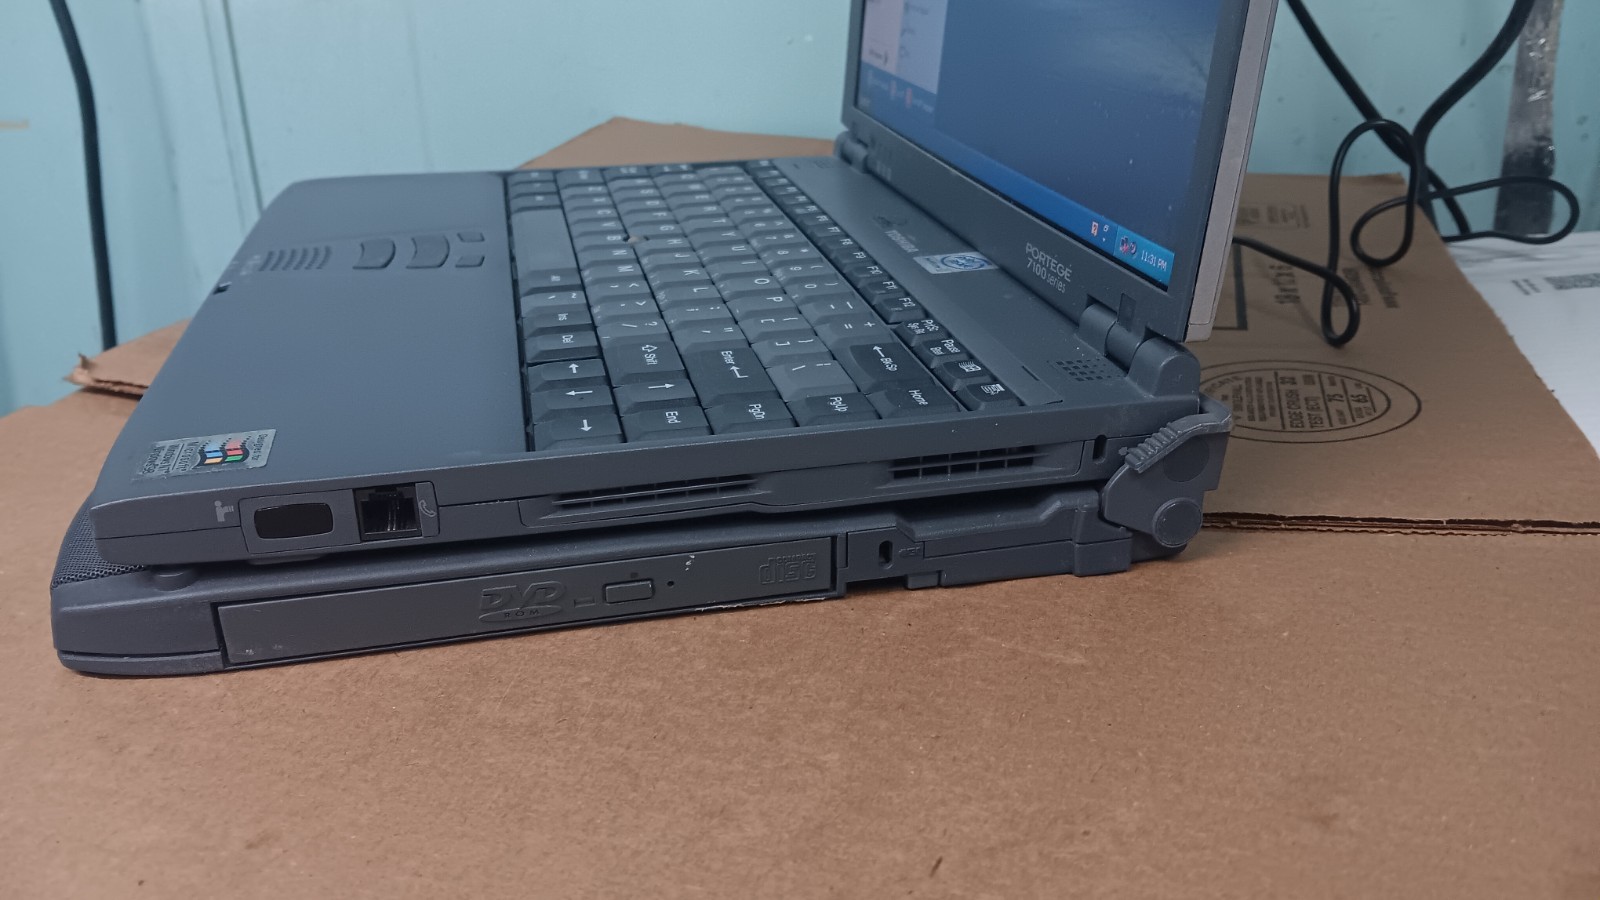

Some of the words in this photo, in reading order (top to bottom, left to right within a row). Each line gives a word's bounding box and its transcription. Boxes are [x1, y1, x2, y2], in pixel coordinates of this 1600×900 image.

[1140, 250, 1157, 266] 11:31
[1156, 258, 1168, 272] PM
[867, 265, 883, 276] F10
[1026, 257, 1047, 280] 7100
[1046, 273, 1066, 294] series
[882, 280, 898, 290] F11
[898, 297, 916, 308] F12
[941, 339, 961, 354] Pause
[721, 350, 736, 365] Enter
[830, 396, 849, 413] PgUp
[908, 389, 929, 406] Home
[665, 410, 682, 425] End
[748, 403, 765, 420] PgDn
[758, 556, 816, 585] disc
[479, 580, 566, 612] DVD
[504, 608, 540, 618] ROM
